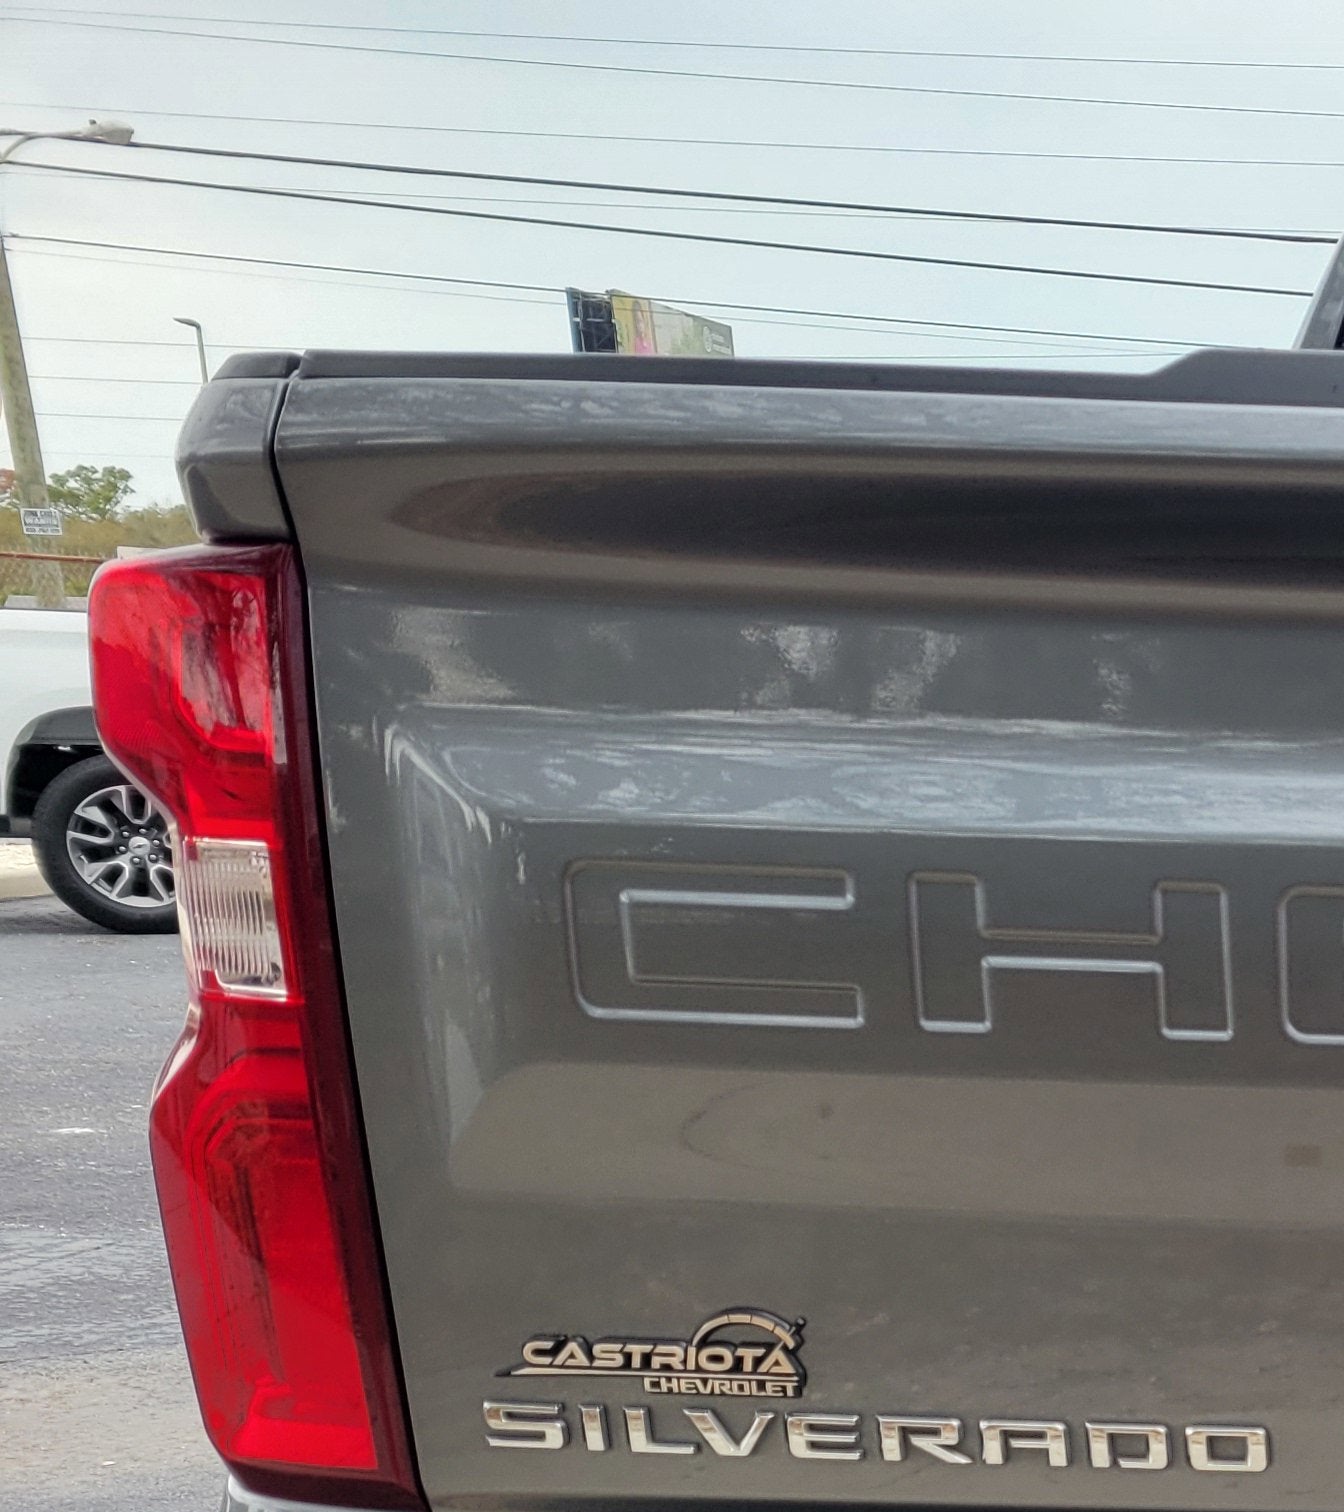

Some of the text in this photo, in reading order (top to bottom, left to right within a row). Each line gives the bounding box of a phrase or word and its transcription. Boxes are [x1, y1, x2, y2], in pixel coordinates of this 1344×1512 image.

[521, 1340, 798, 1374] CASTRIOTA
[643, 1376, 800, 1398] CHEVROLET
[482, 1400, 1271, 1473] SILVERADO
